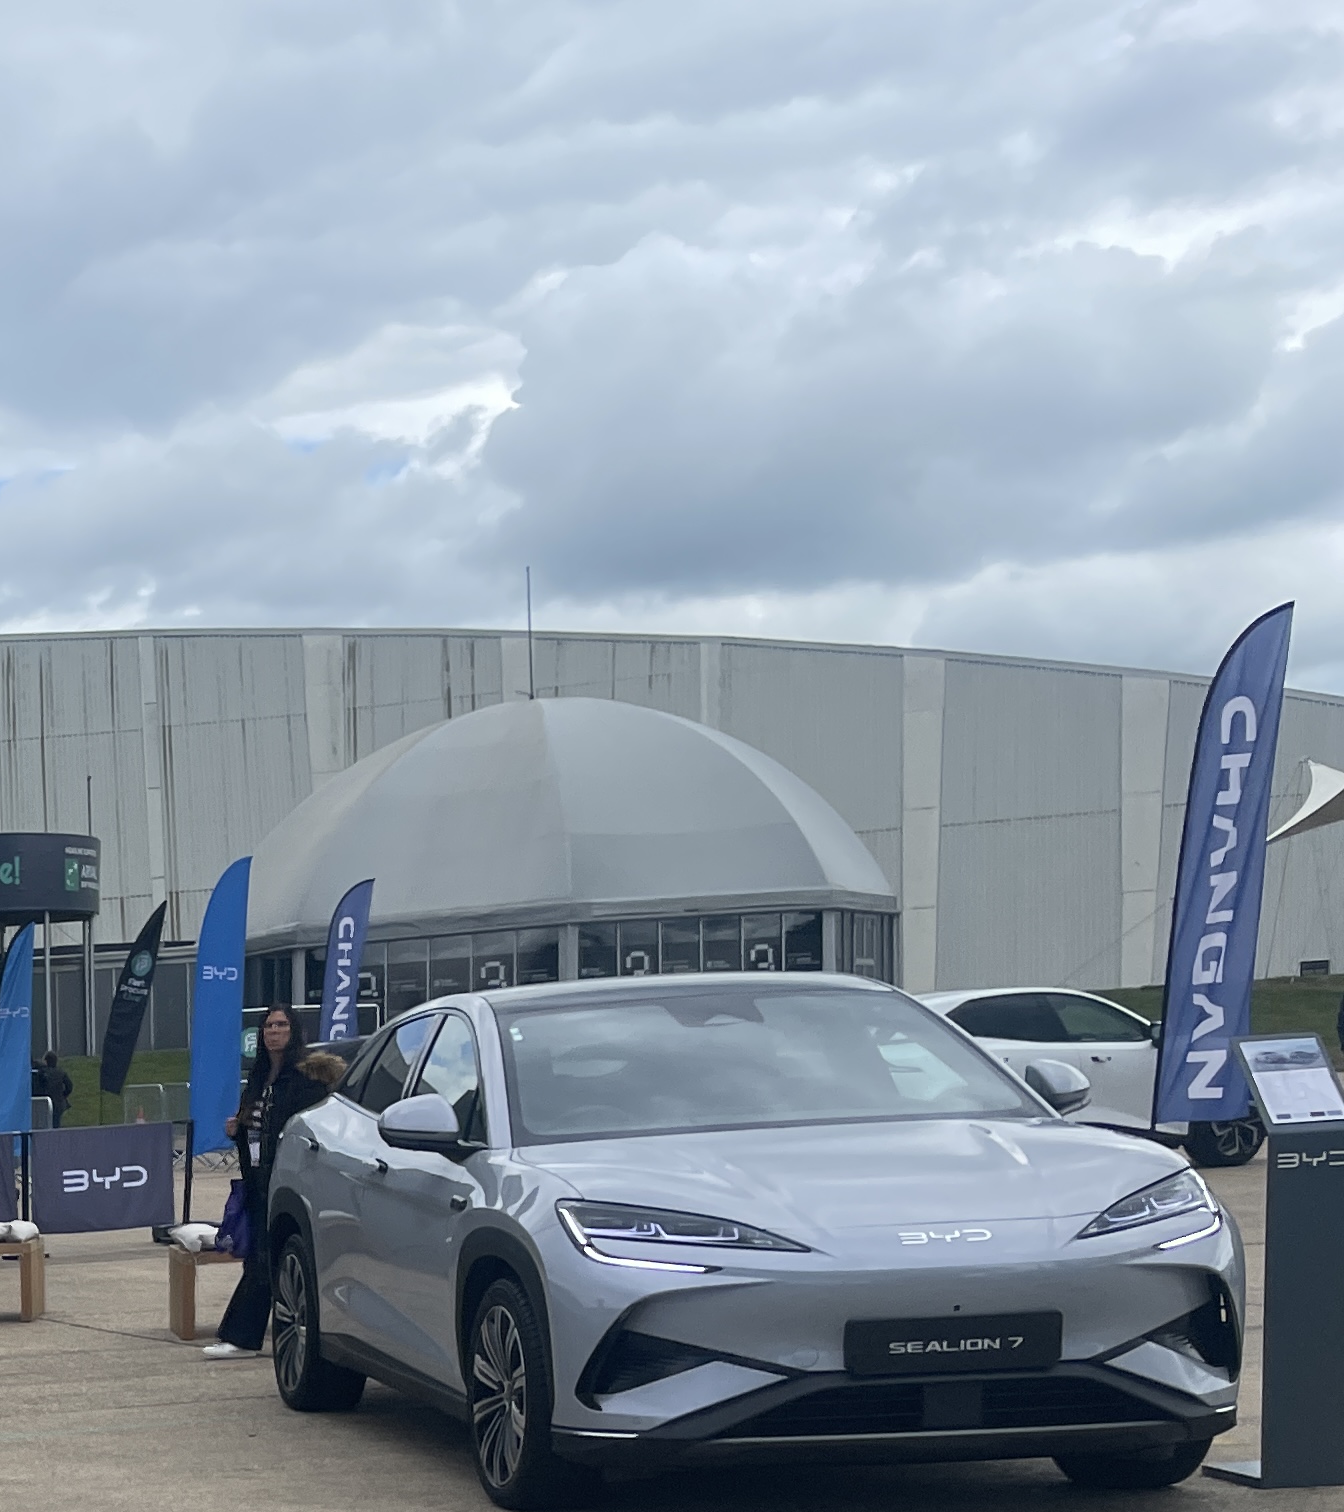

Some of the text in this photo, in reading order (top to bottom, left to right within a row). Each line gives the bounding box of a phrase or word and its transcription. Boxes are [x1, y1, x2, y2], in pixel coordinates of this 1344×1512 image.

[1185, 694, 1258, 1100] CHANGAN
[202, 965, 239, 981] BYD
[62, 1165, 148, 1192] BYD
[898, 1228, 993, 1245] BYD
[888, 1336, 1024, 1354] SEALION 7
